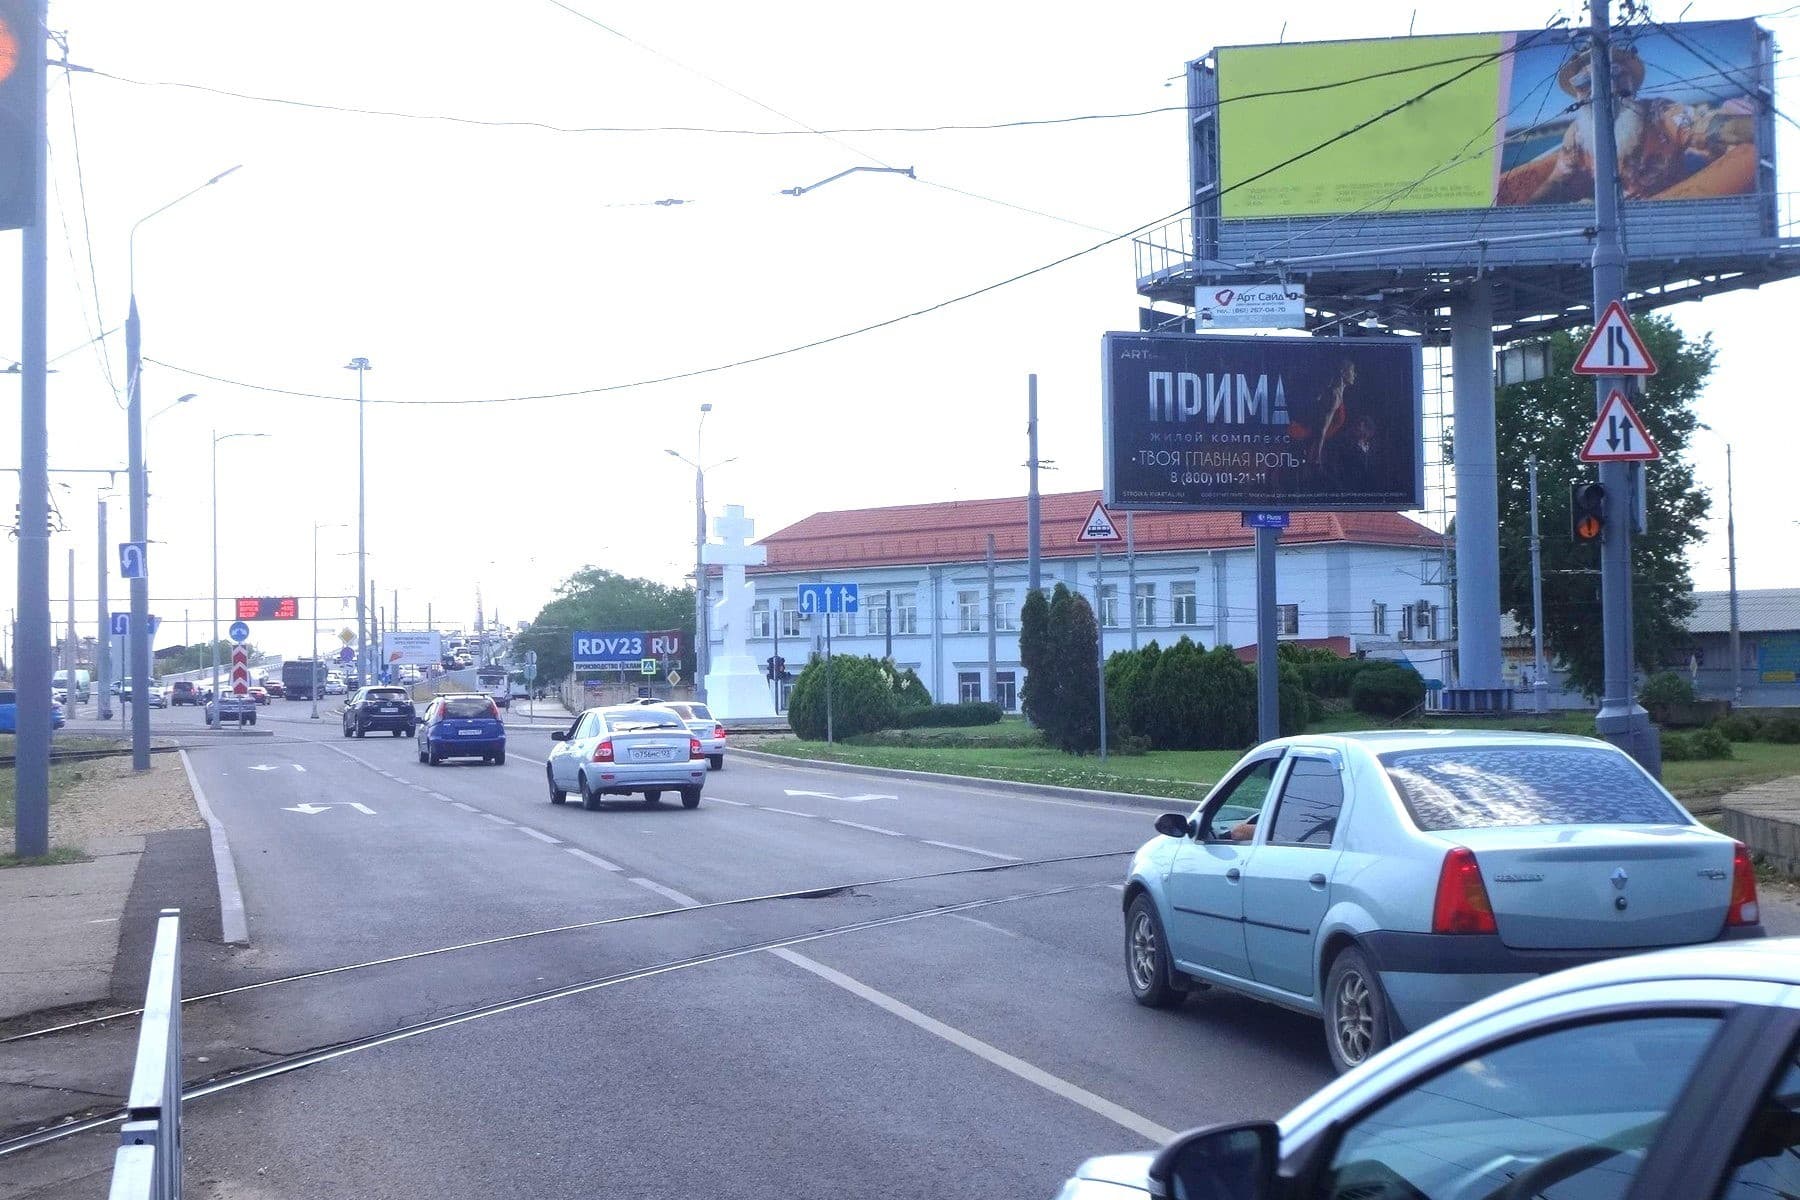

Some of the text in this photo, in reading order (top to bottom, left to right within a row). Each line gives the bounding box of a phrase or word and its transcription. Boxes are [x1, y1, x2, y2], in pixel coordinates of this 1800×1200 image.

[1237, 292, 1285, 303] Арт Сайд
[1149, 371, 1290, 424] ПРИМА
[1139, 450, 1300, 468] ТВОЯ ГЛАВНАЯ РОЛЬ
[1170, 472, 1266, 485] 8 (800) 101-21-11
[578, 637, 678, 655] RDV23 RU
